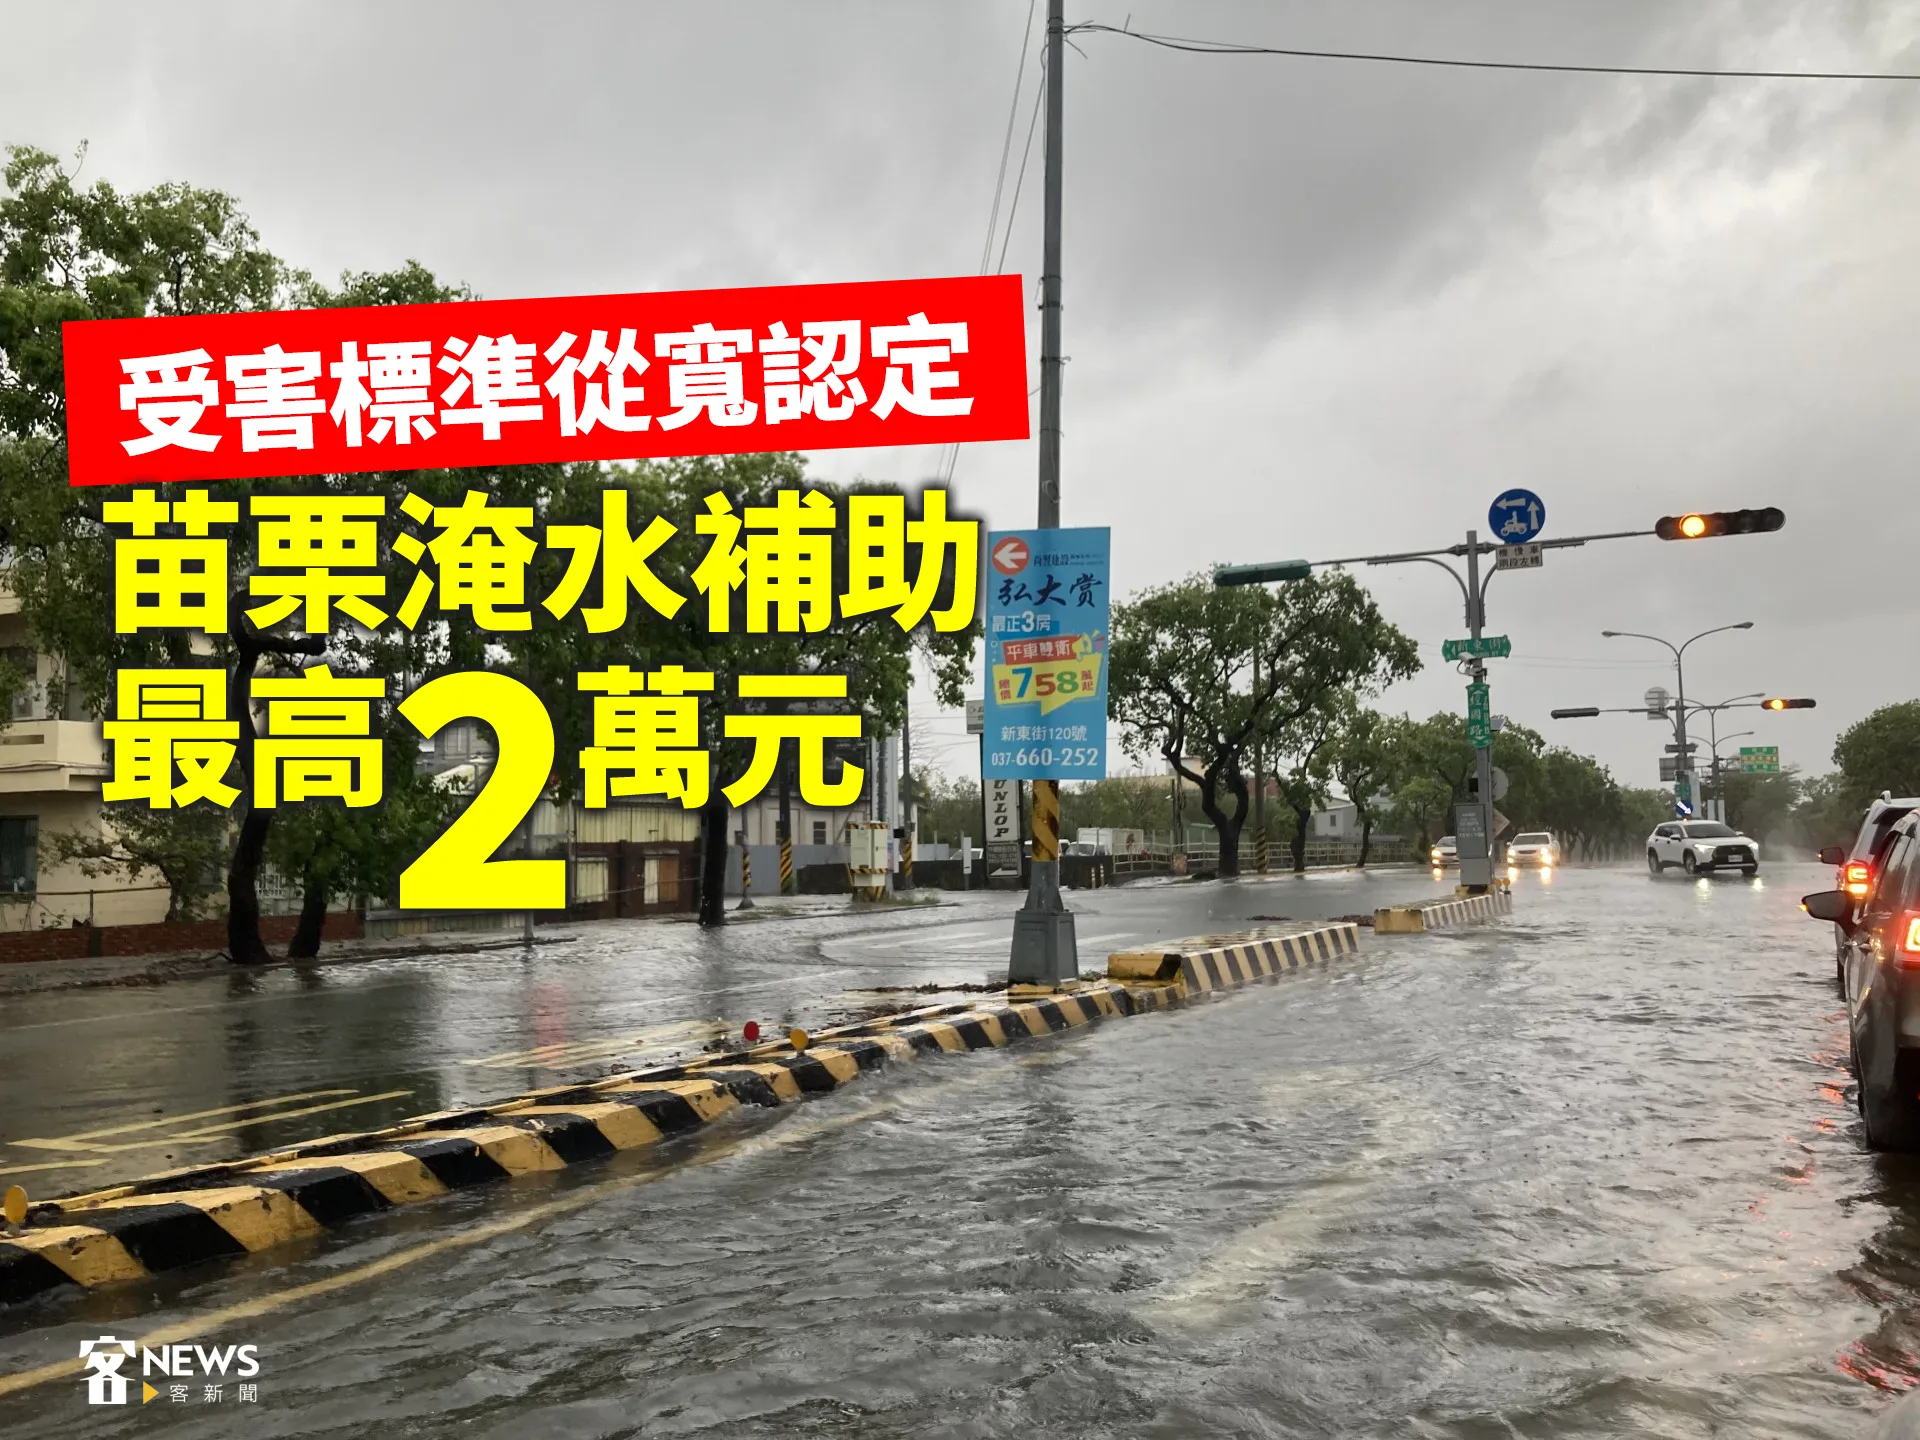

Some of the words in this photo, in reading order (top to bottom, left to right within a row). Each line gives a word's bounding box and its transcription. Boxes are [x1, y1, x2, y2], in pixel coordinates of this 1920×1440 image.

[992, 610, 1051, 633] 最正3房
[1007, 639, 1070, 661] 平車雙衛
[1012, 667, 1079, 698] 758
[1001, 725, 1087, 742] 新東街120號
[992, 747, 1099, 766] 037-660-252
